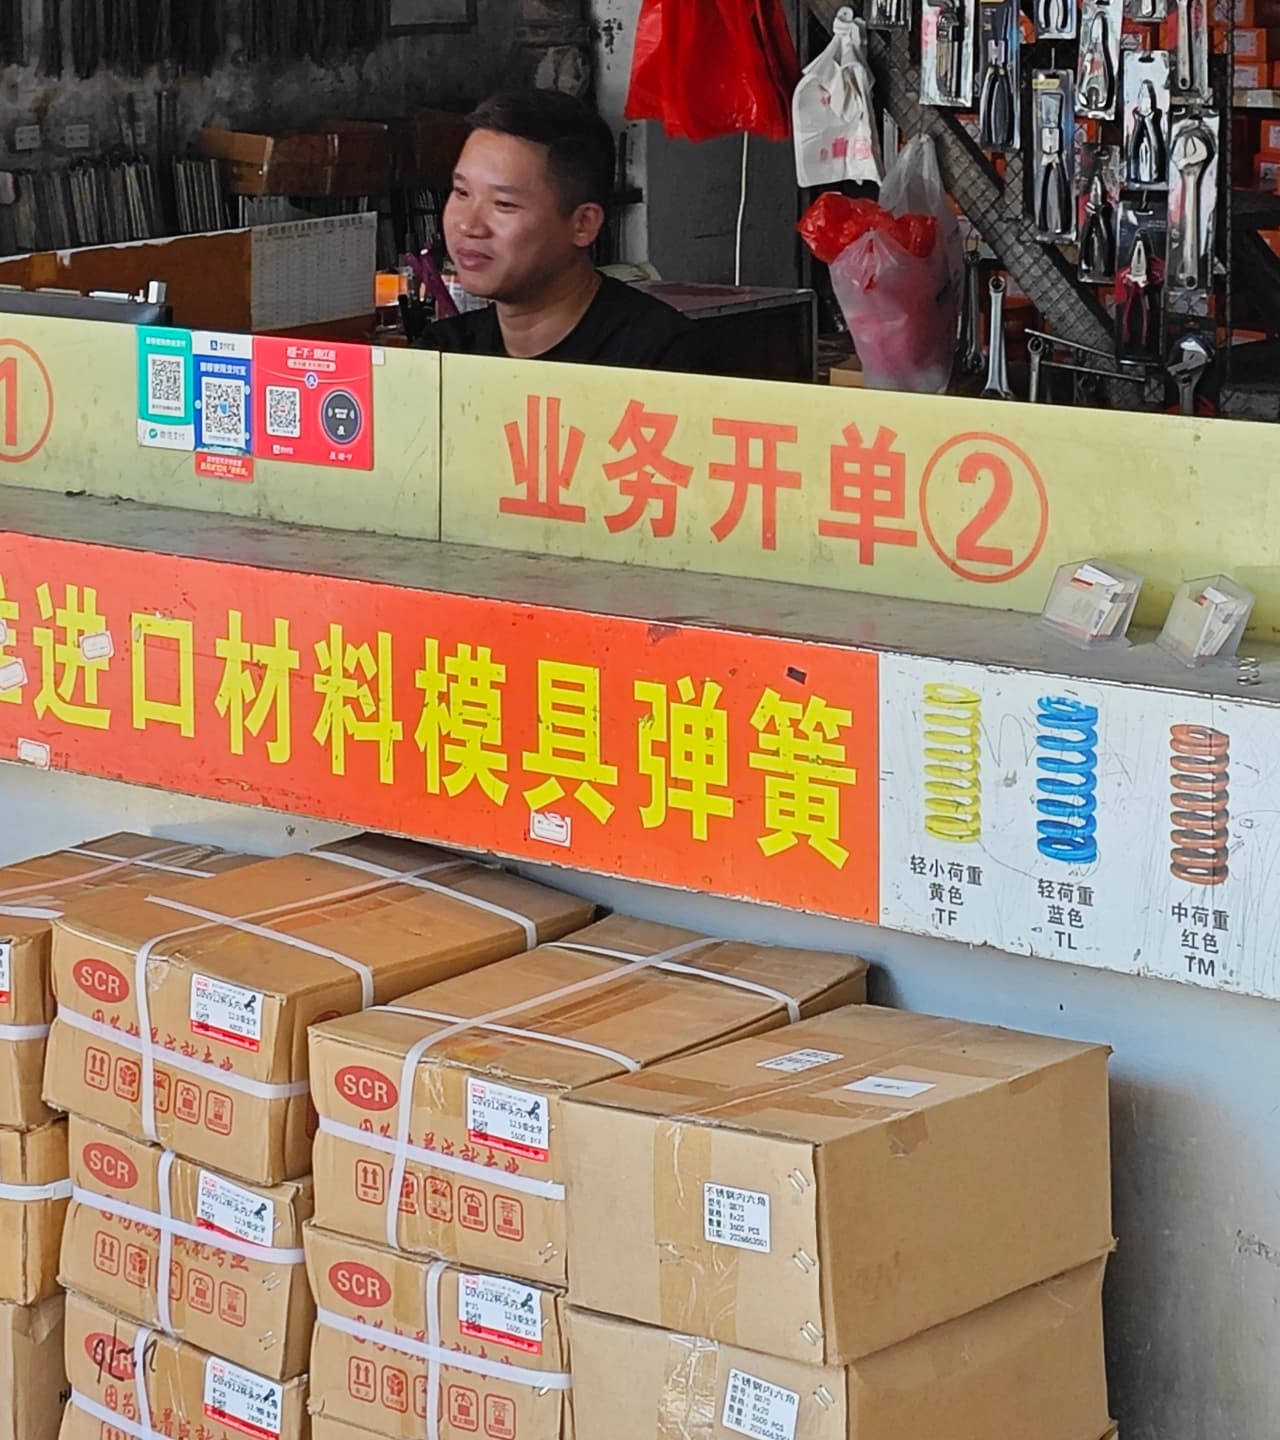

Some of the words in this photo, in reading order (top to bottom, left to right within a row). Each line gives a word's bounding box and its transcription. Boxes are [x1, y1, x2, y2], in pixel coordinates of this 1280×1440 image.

[909, 854, 984, 887] 轻小荷重
[928, 882, 965, 907] 黄色
[1037, 878, 1095, 908] 轻荷重
[935, 908, 958, 926] TF
[1047, 904, 1085, 929] 蓝色
[1171, 902, 1230, 932] 中荷重
[1054, 930, 1078, 951] TL
[1181, 930, 1220, 955] 红色
[79, 965, 121, 997] SCR
[1184, 955, 1216, 977] TM
[342, 1073, 389, 1105] SCR
[88, 1149, 131, 1184] SCR
[705, 1185, 766, 1208] 不锈钢内六角
[336, 1269, 382, 1301] SCR
[731, 1372, 796, 1406] 不锈钢内六角
